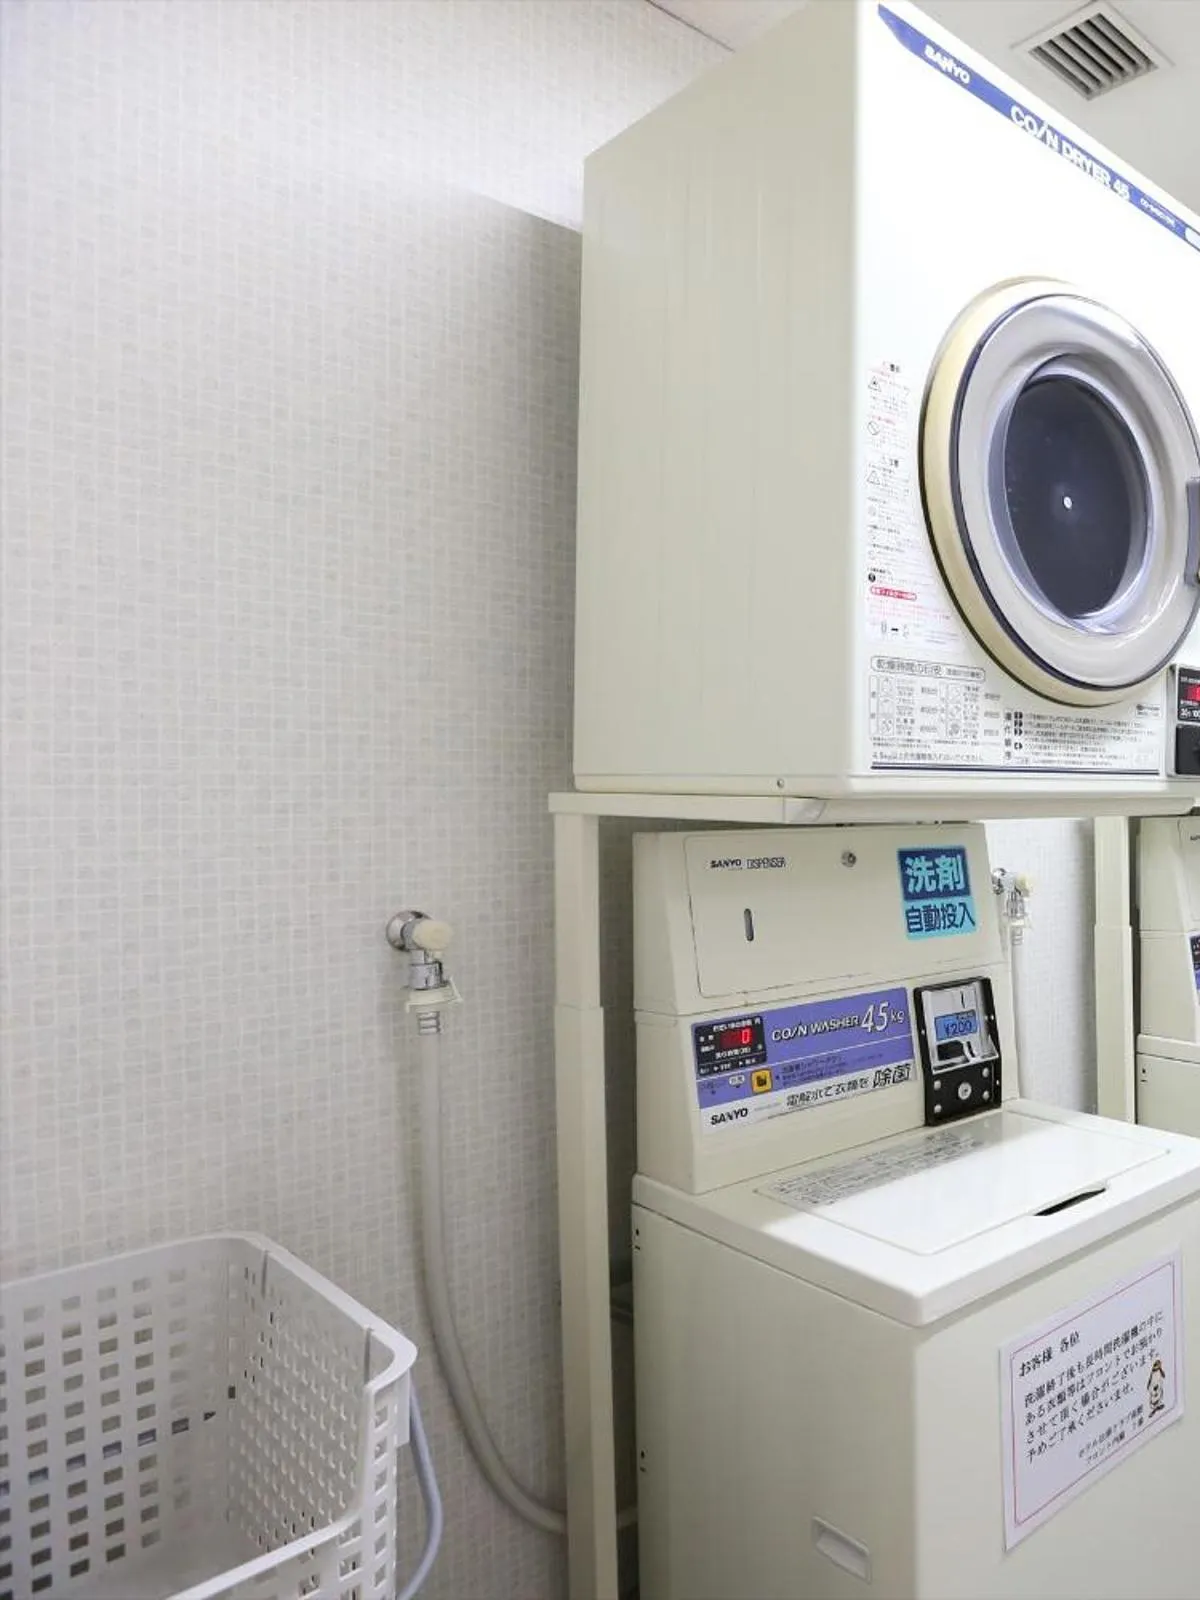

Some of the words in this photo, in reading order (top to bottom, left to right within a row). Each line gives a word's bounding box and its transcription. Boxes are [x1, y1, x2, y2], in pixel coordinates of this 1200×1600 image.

[924, 44, 971, 84] SANYO
[1061, 139, 1111, 188] DRYER
[710, 858, 742, 869] SANYO
[904, 853, 966, 893] 洗剤
[905, 901, 976, 933] 自動投入
[810, 1015, 859, 1034] WASHER
[710, 1106, 748, 1126] SANYO
[1018, 1346, 1053, 1377] お客様
